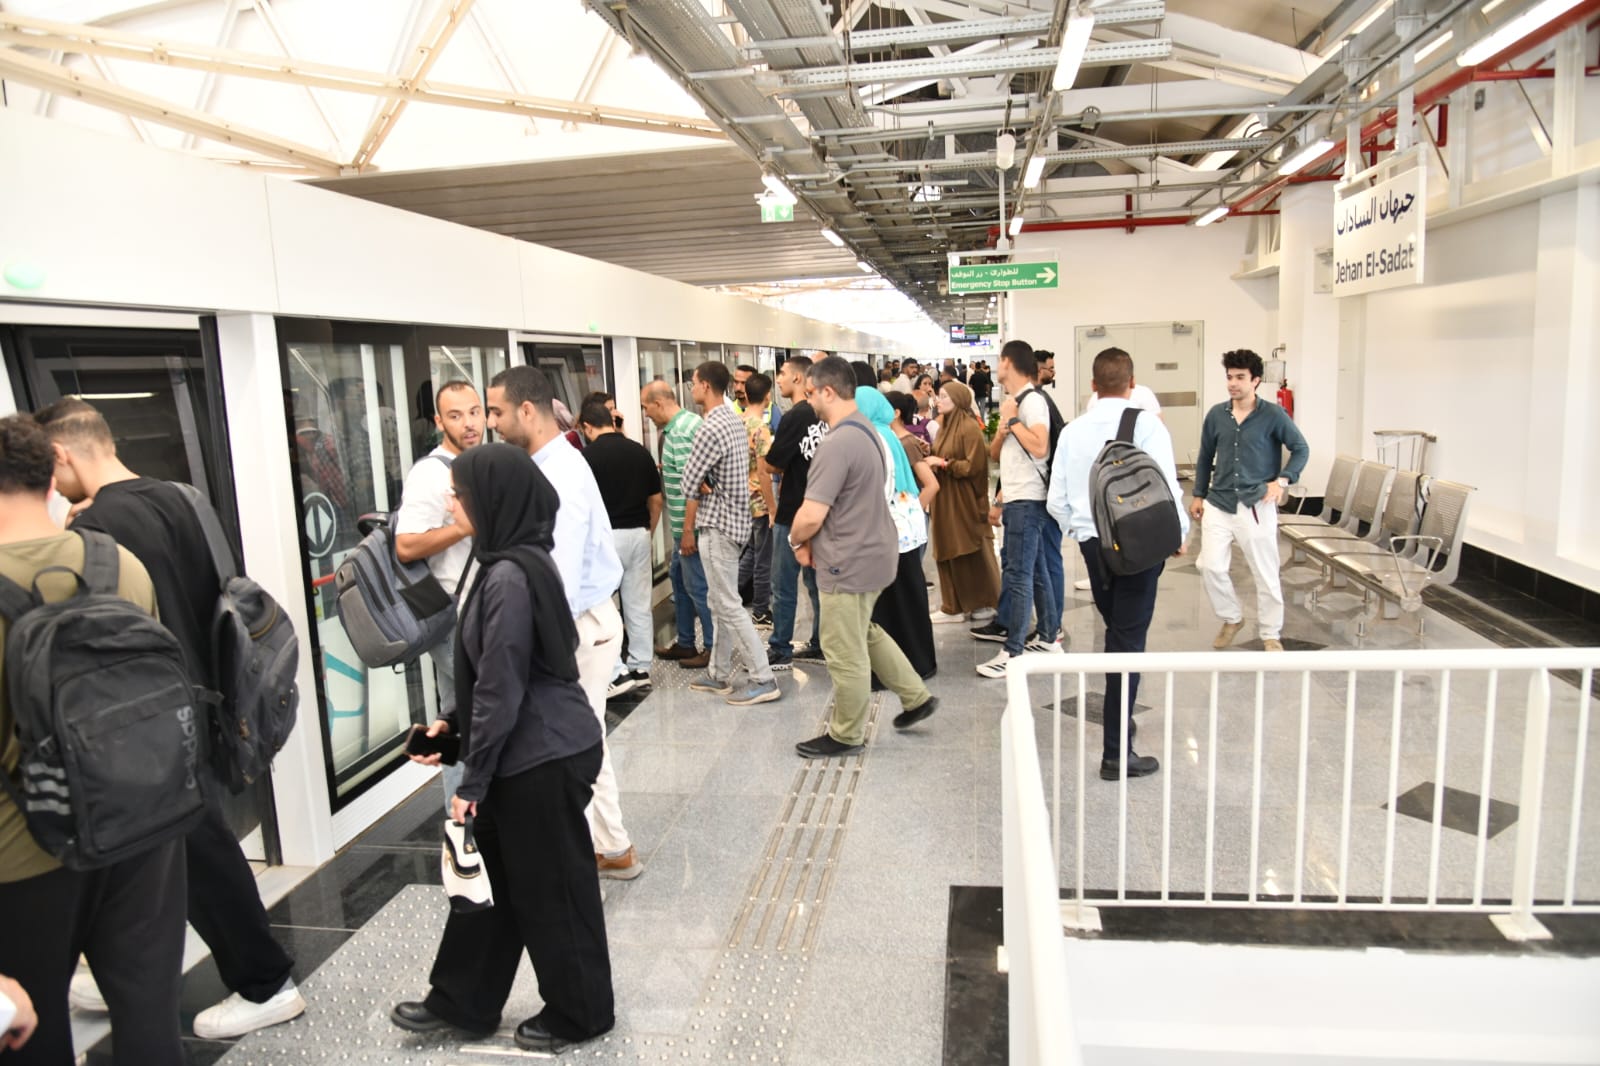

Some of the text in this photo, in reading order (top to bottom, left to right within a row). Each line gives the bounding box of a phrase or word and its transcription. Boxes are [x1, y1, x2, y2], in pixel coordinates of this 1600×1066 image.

[1379, 189, 1415, 224] جيهان
[1335, 243, 1414, 284] Jehan El-Sadat
[951, 278, 1038, 290] Emergency Stop Button
